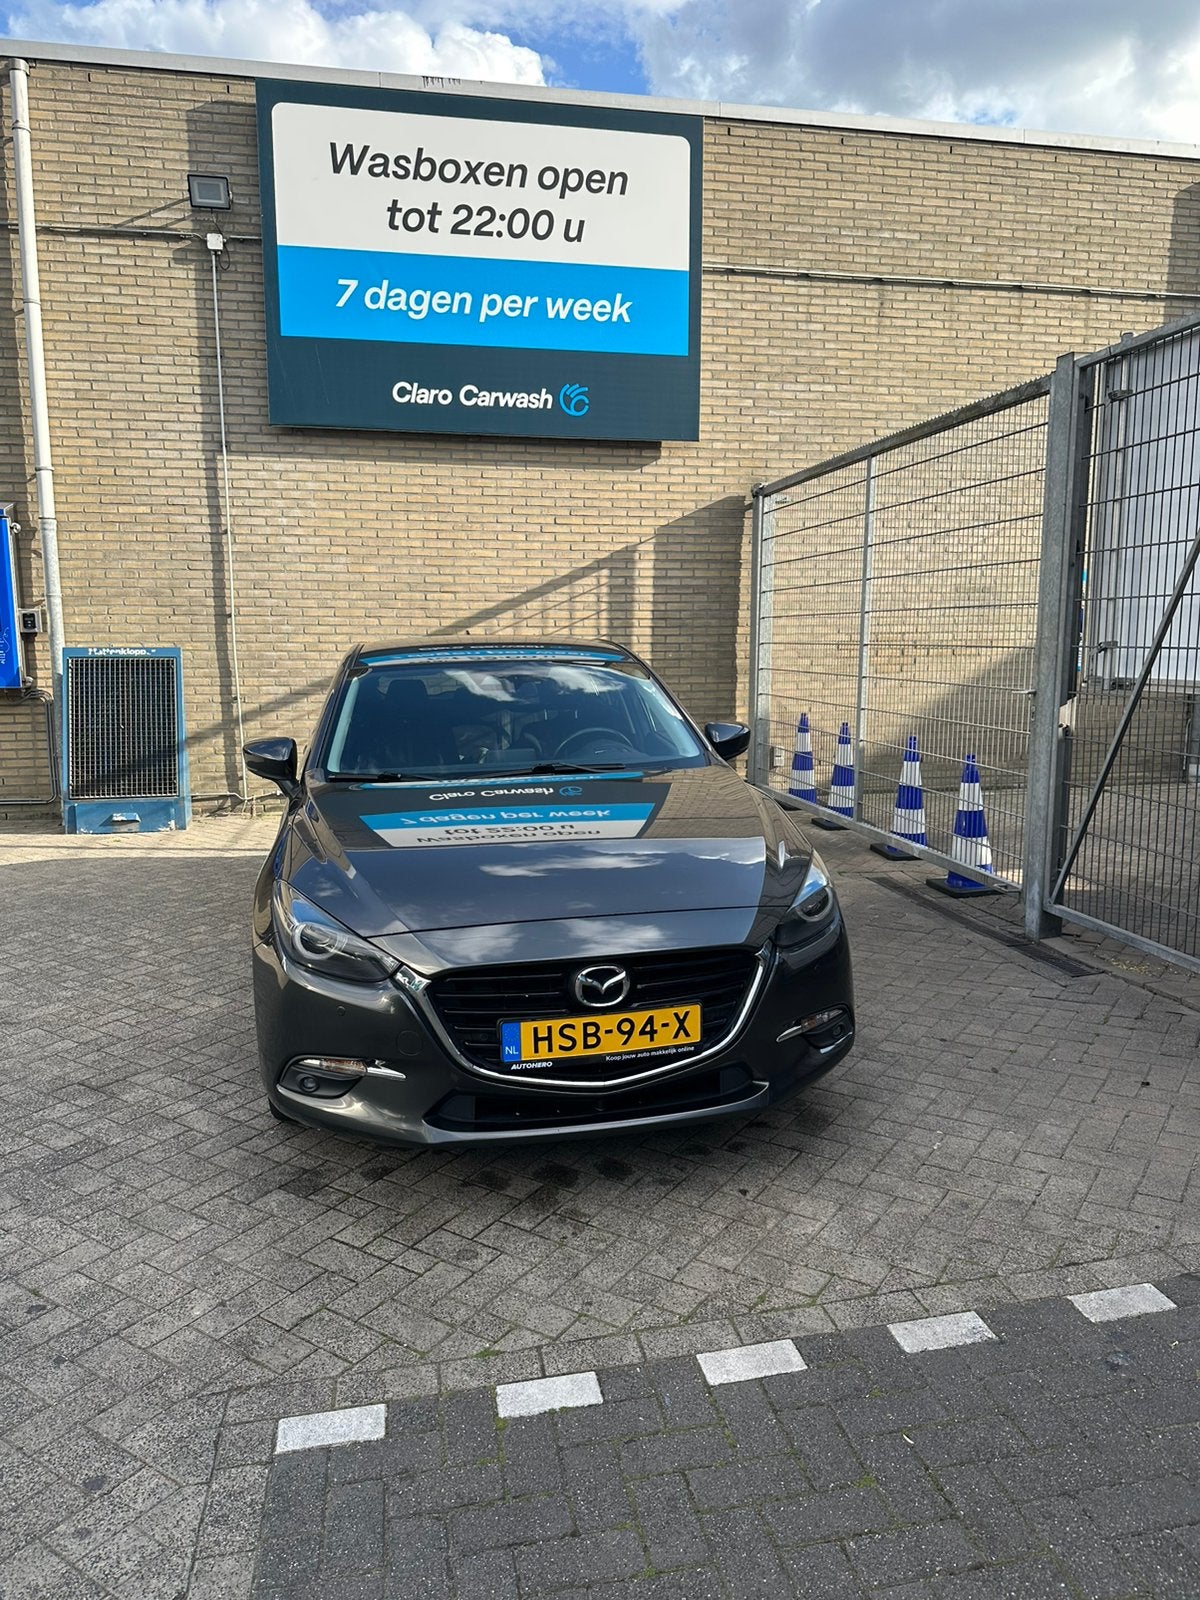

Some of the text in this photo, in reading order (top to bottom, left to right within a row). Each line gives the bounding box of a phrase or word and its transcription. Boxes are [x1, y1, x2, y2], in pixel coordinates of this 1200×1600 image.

[329, 141, 629, 199] Wasboxen open
[387, 198, 586, 243] tot 22:00 u
[335, 278, 633, 323] 7 dagen per week
[392, 381, 553, 410] Claro Carwash
[88, 648, 156, 656] Mattenklopp
[505, 1010, 691, 1055] NL HSB-94-X
[510, 1061, 553, 1071] AUTOHERO
[650, 1048, 677, 1056] makkelijk
